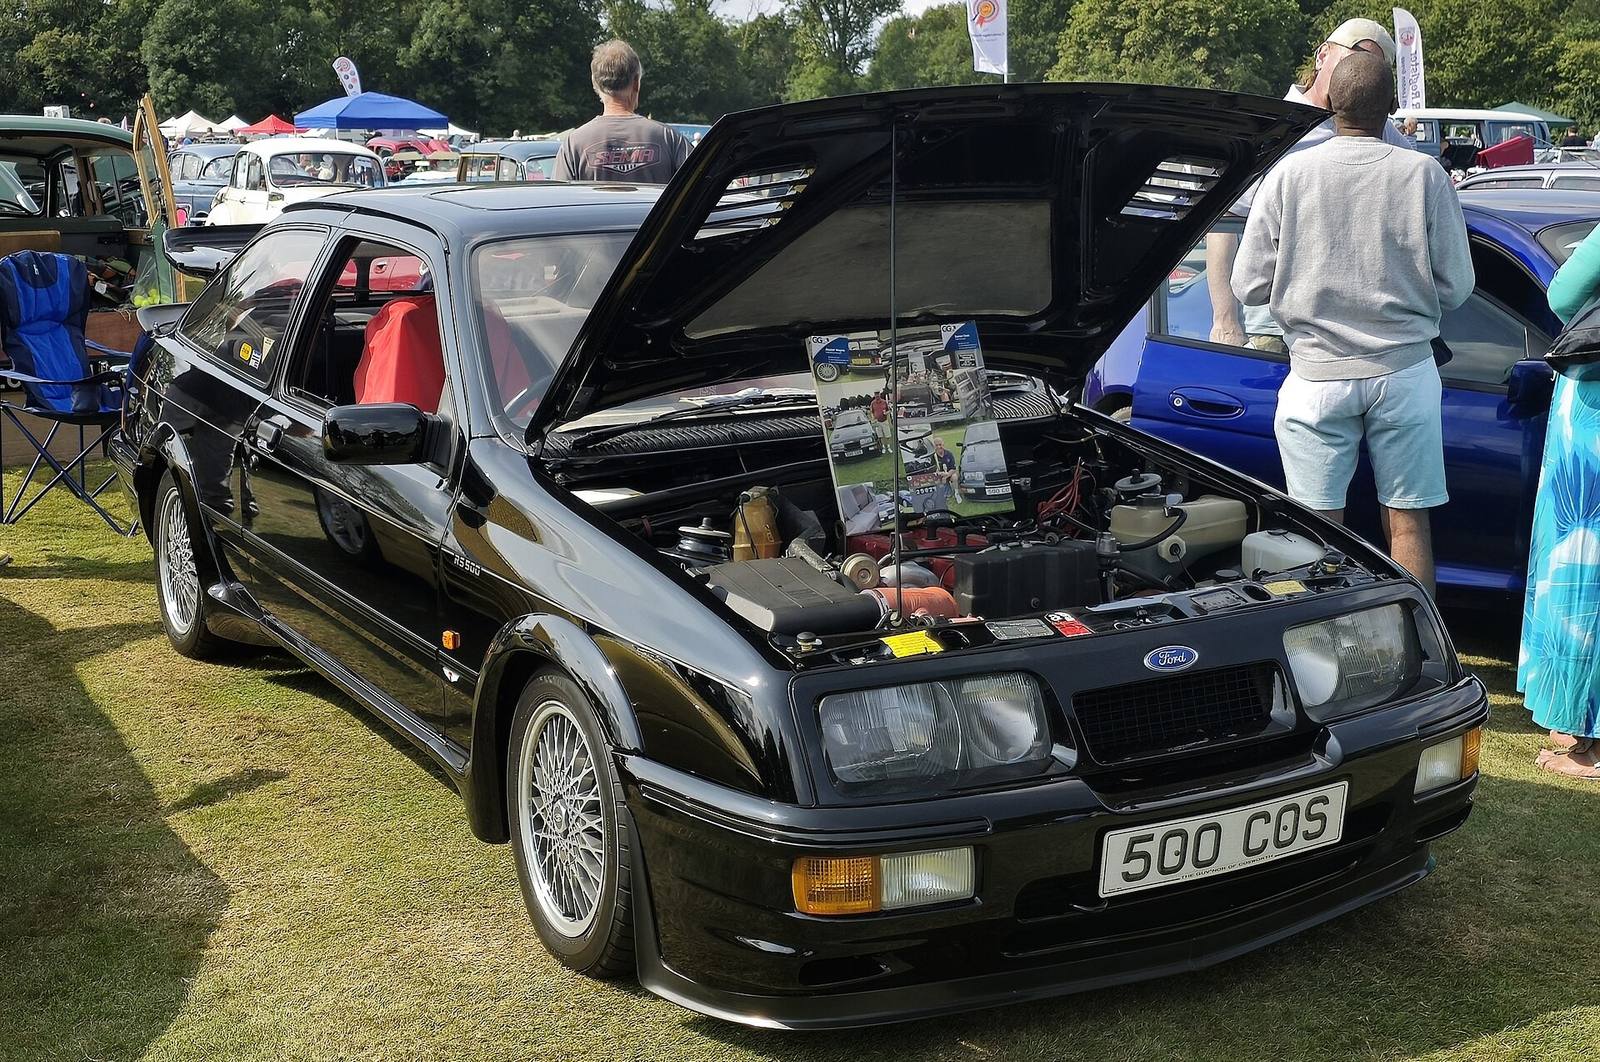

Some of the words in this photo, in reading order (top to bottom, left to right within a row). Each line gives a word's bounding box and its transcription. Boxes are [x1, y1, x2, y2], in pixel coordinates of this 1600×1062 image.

[1158, 650, 1187, 666] Ford
[1121, 821, 1223, 882] 500
[1242, 795, 1330, 858] COS
[1238, 854, 1275, 867] COSWORTH
